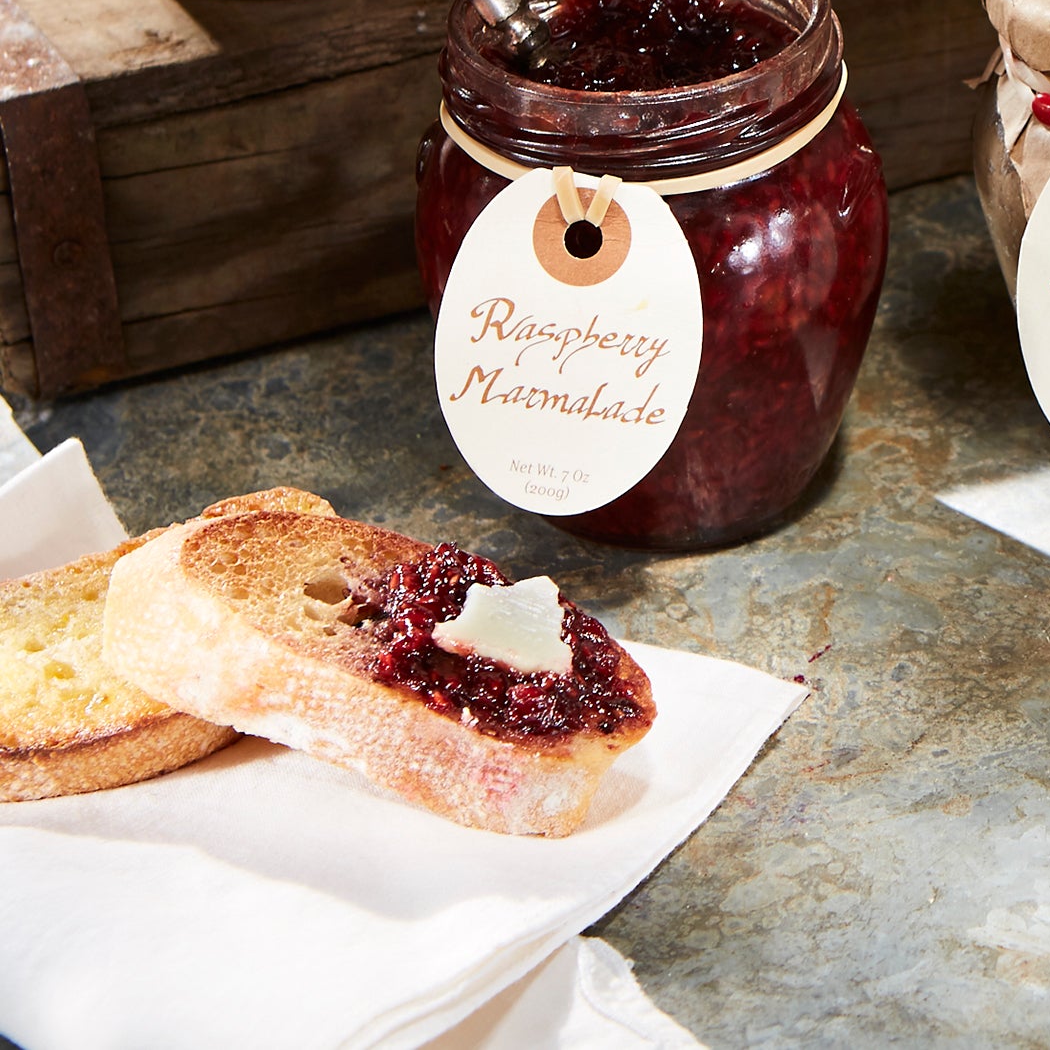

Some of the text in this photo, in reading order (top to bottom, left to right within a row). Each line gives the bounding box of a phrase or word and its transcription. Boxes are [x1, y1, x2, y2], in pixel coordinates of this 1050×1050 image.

[469, 296, 673, 380] Raspberry
[448, 363, 668, 426] Marmalade
[508, 457, 592, 485] Net Wt. 7 Oz
[523, 480, 571, 502] (200g)
